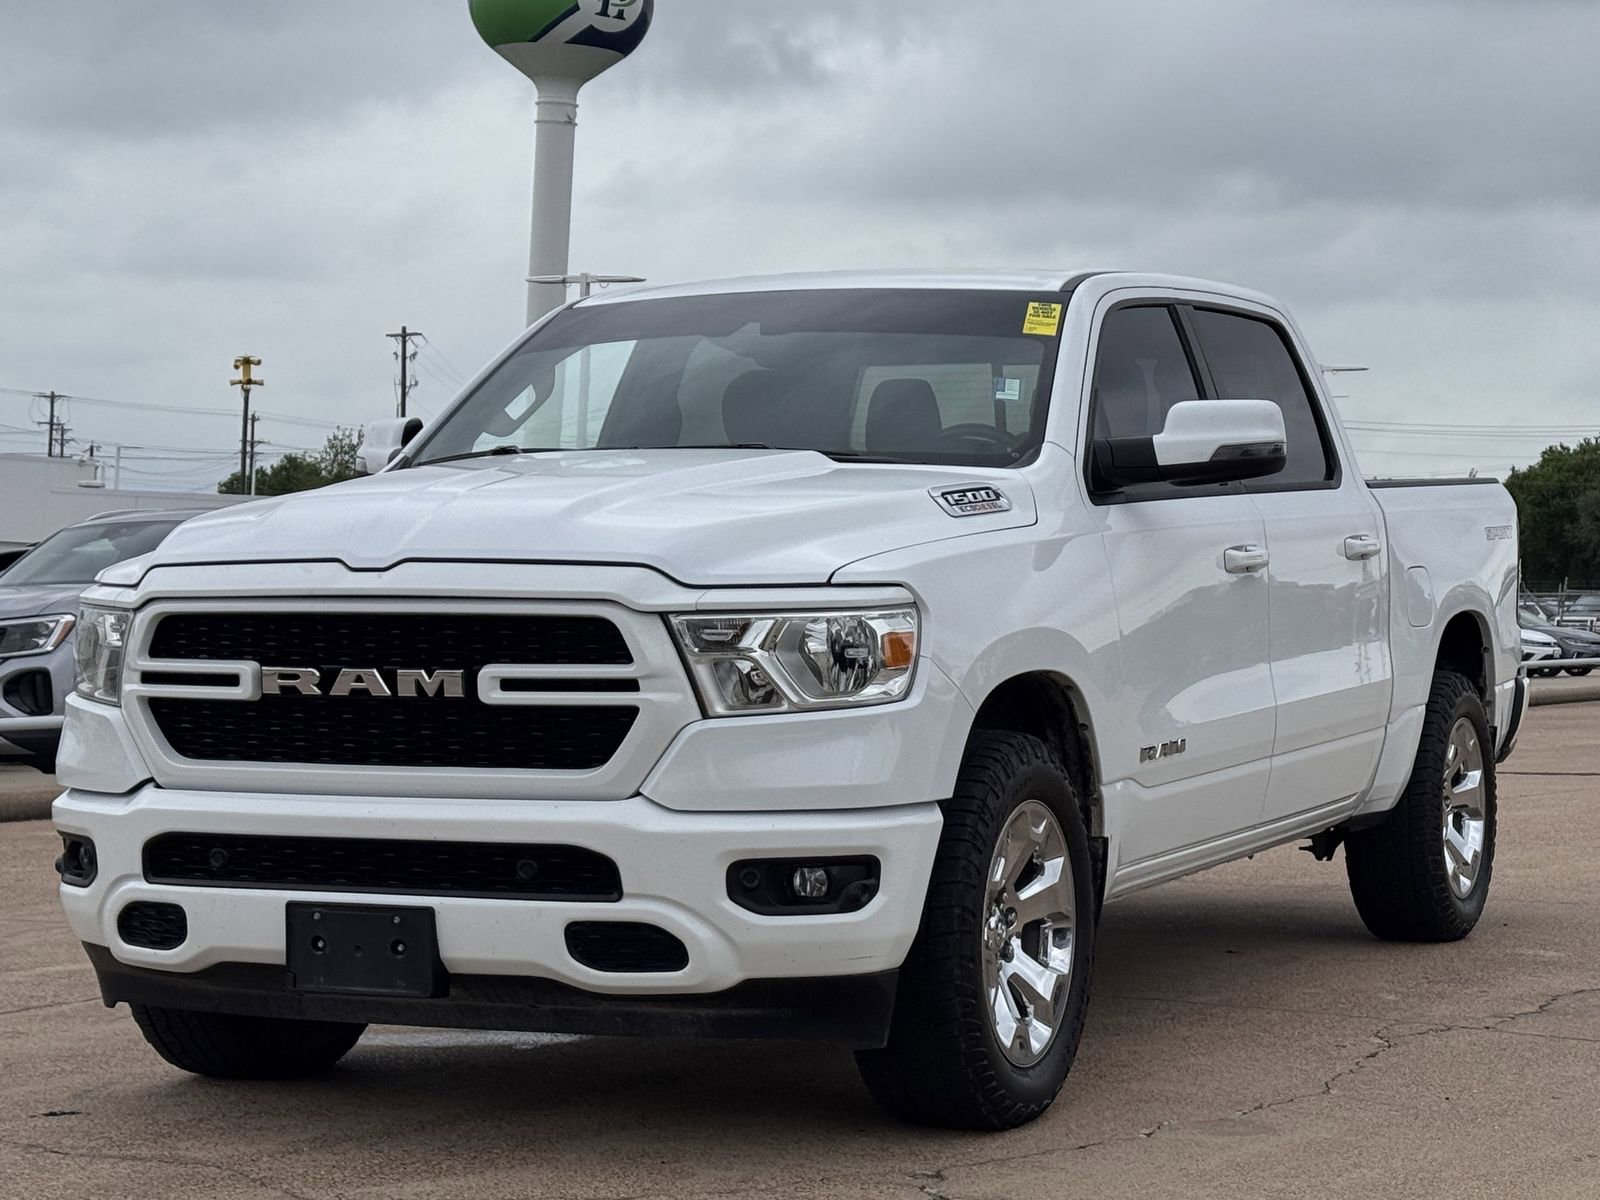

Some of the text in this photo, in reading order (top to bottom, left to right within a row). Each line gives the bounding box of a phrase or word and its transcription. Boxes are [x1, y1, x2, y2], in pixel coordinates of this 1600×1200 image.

[943, 489, 997, 505] 1500
[960, 501, 1002, 513] ECODIESEL
[261, 666, 465, 697] RAM
[1140, 738, 1186, 763] RAM
